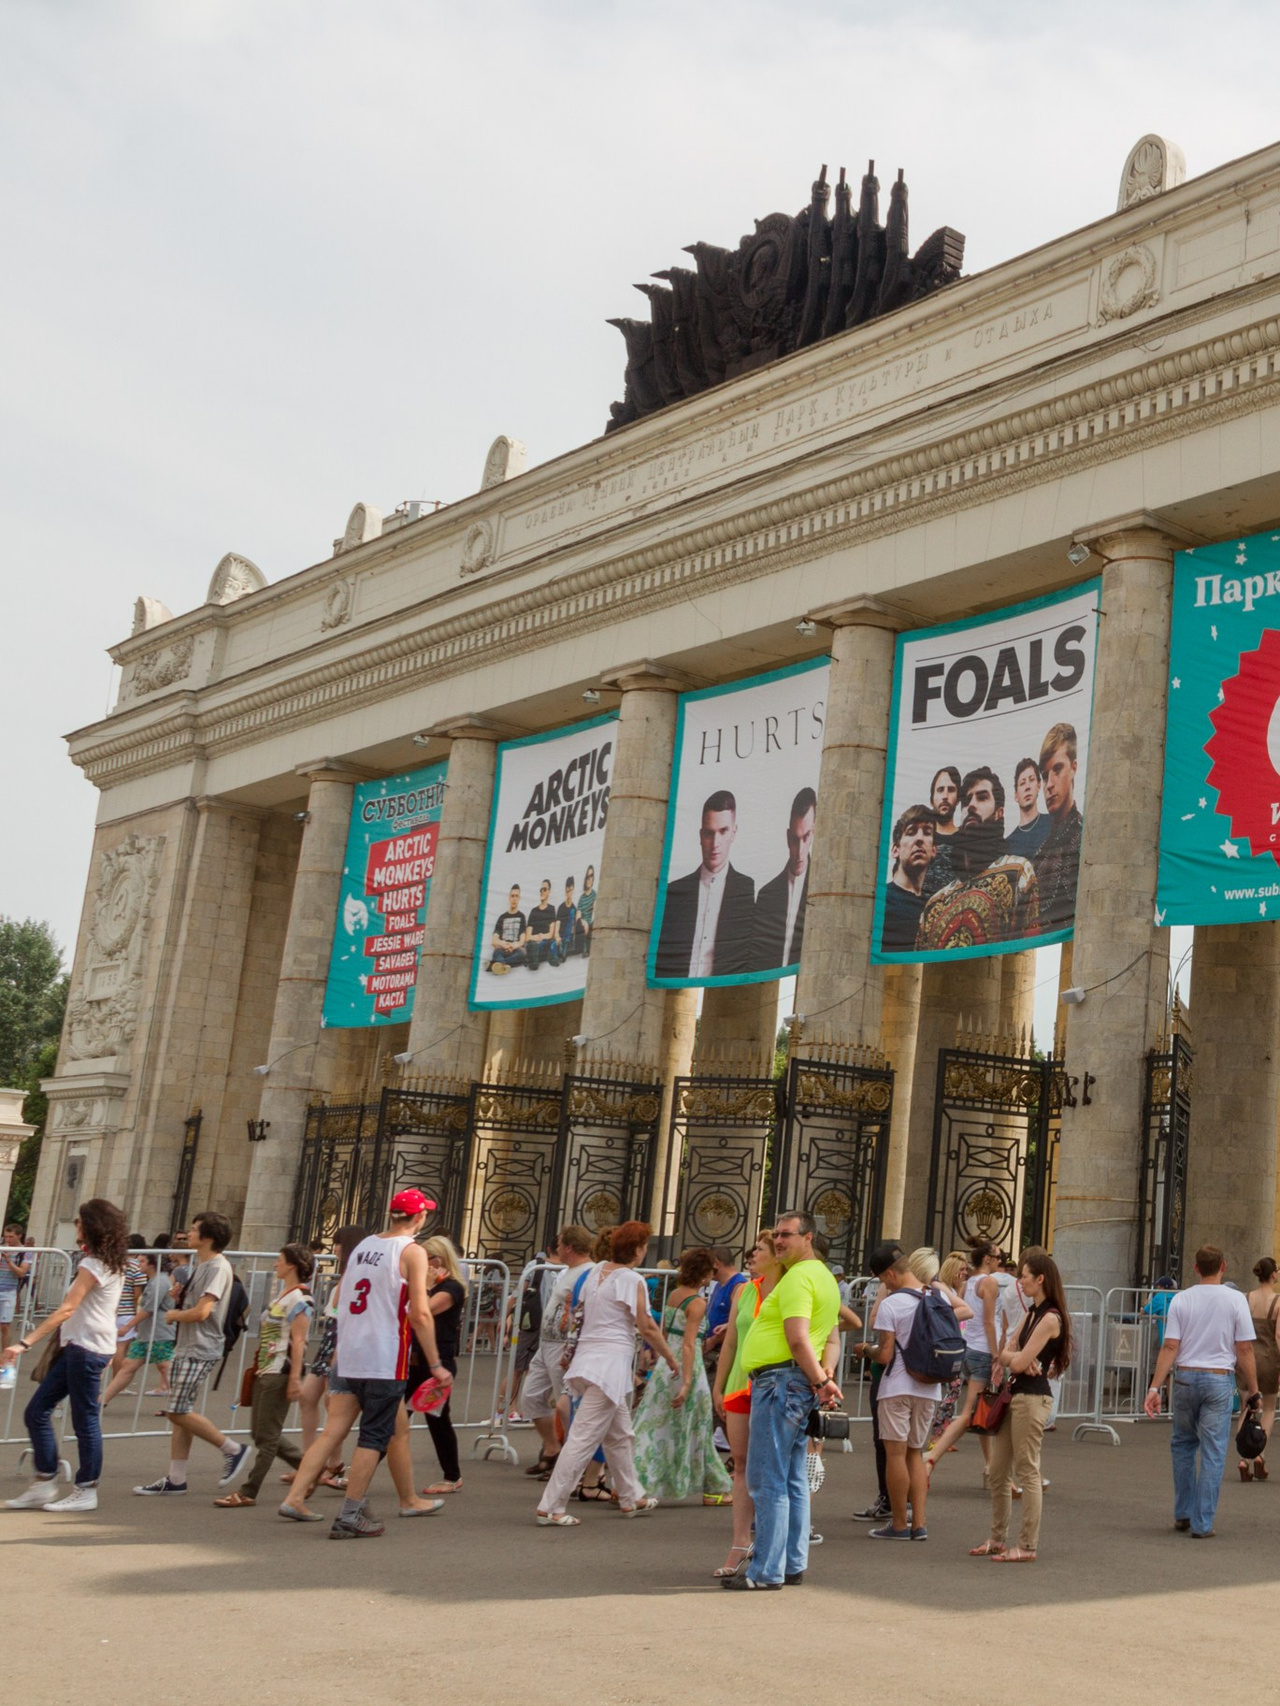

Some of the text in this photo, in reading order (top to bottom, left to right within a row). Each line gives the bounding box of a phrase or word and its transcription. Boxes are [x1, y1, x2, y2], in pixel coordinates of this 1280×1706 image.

[973, 302, 1053, 349] ОТДЫХА
[911, 625, 1087, 724] FOALS
[699, 701, 824, 765] HURTS
[522, 741, 612, 820] ARCTIC
[505, 785, 611, 853] MONKEYS
[384, 833, 432, 862] ARCTIC
[373, 856, 434, 888] MONKEYS
[382, 885, 423, 912] HURTS
[389, 913, 415, 931] FOALS
[370, 930, 425, 953] JESSIE WARE
[379, 952, 415, 970] SAVAGES
[371, 971, 415, 991] MOTORAMA
[357, 1251, 384, 1266] WADE
[349, 1277, 372, 1315] 3
